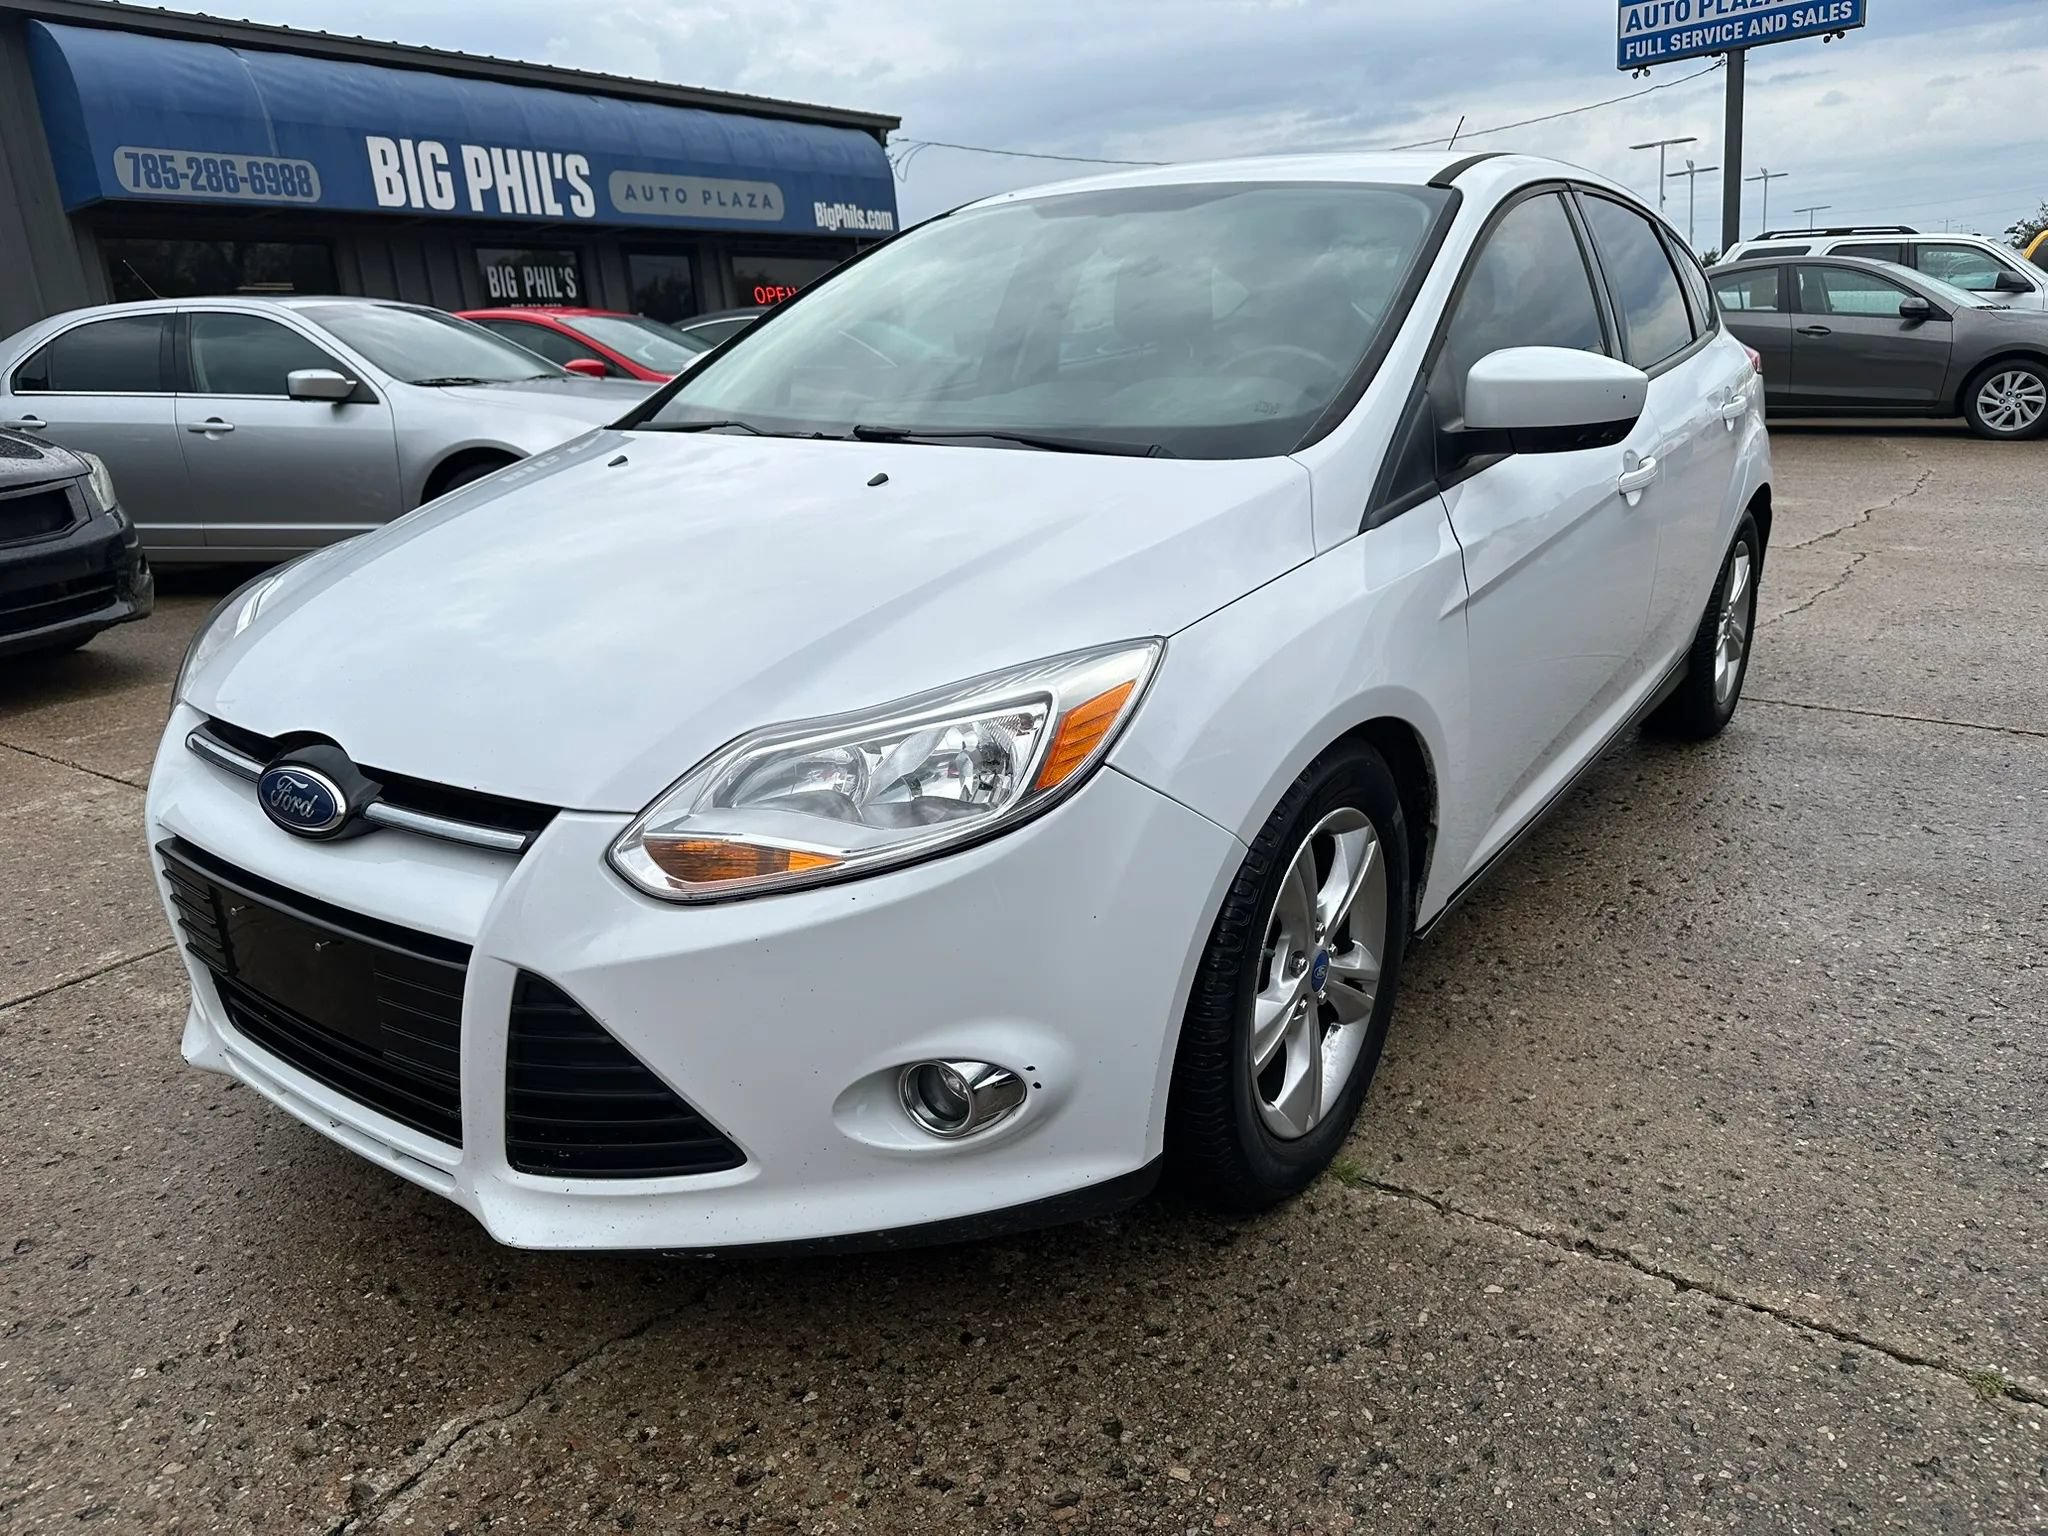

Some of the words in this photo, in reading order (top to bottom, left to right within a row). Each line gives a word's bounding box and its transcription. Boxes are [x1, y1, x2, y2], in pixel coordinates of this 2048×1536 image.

[1625, 1, 1691, 33] AUTO
[1626, 38, 1666, 60] FULL
[1670, 21, 1744, 51] SERVICE
[1747, 13, 1787, 37] AND
[1792, 1, 1853, 28] SALES
[124, 152, 314, 198] 785-286-6988
[365, 135, 456, 211] BIG
[460, 144, 596, 218] PHIL'S
[624, 183, 688, 204] AUTO
[702, 190, 774, 210] PLAZA
[814, 202, 894, 231] BigPhils.com
[486, 265, 519, 298] BIG
[523, 266, 577, 299] PHIL'S
[270, 775, 318, 818] Ford
